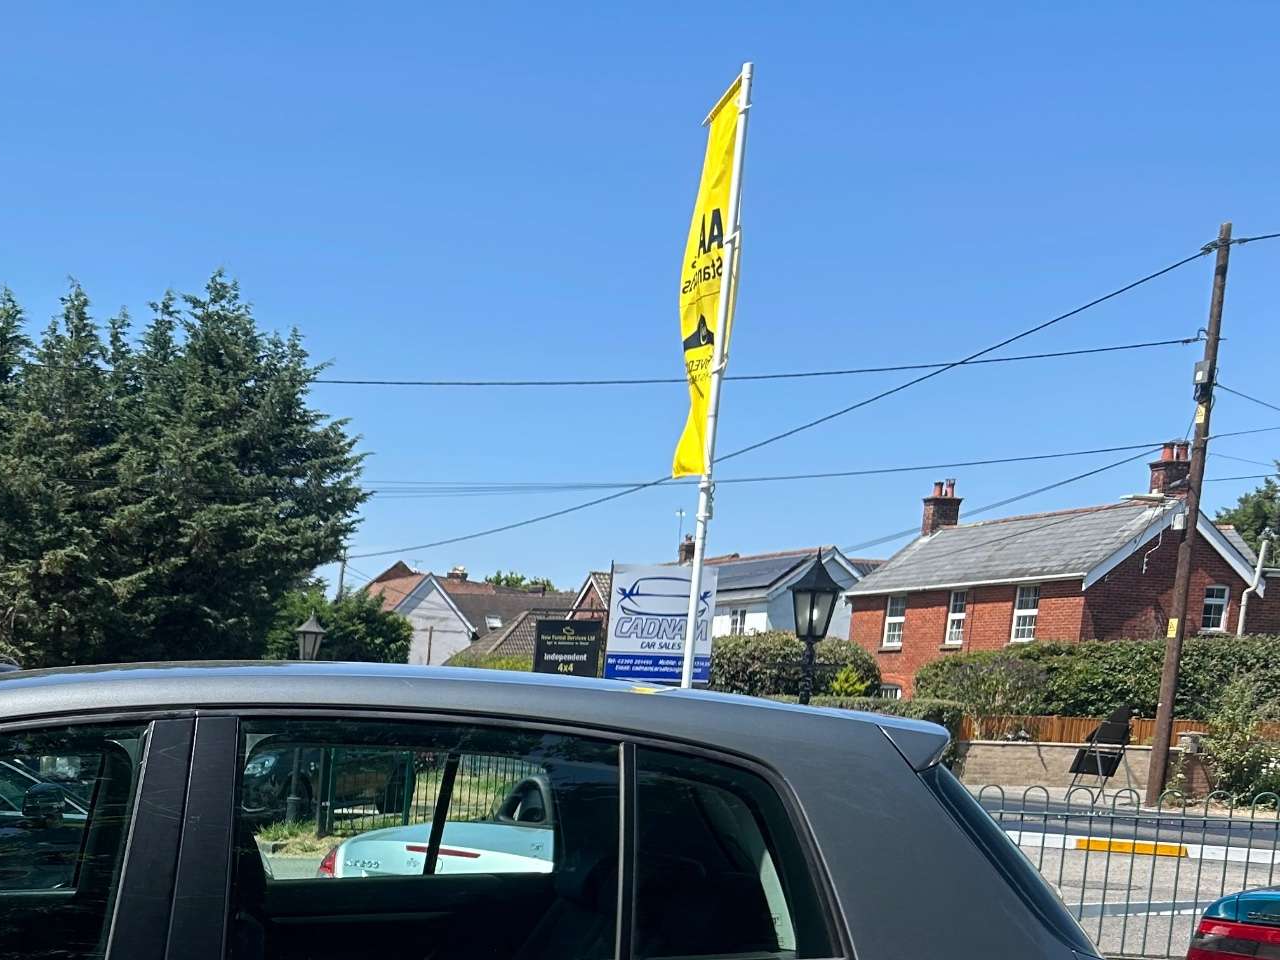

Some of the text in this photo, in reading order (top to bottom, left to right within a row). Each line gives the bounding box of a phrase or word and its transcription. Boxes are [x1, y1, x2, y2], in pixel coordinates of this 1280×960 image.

[614, 616, 708, 641] CADNAM
[640, 641, 682, 650] CAR SALES
[544, 652, 587, 662] Independent
[557, 662, 574, 672] 4x4
